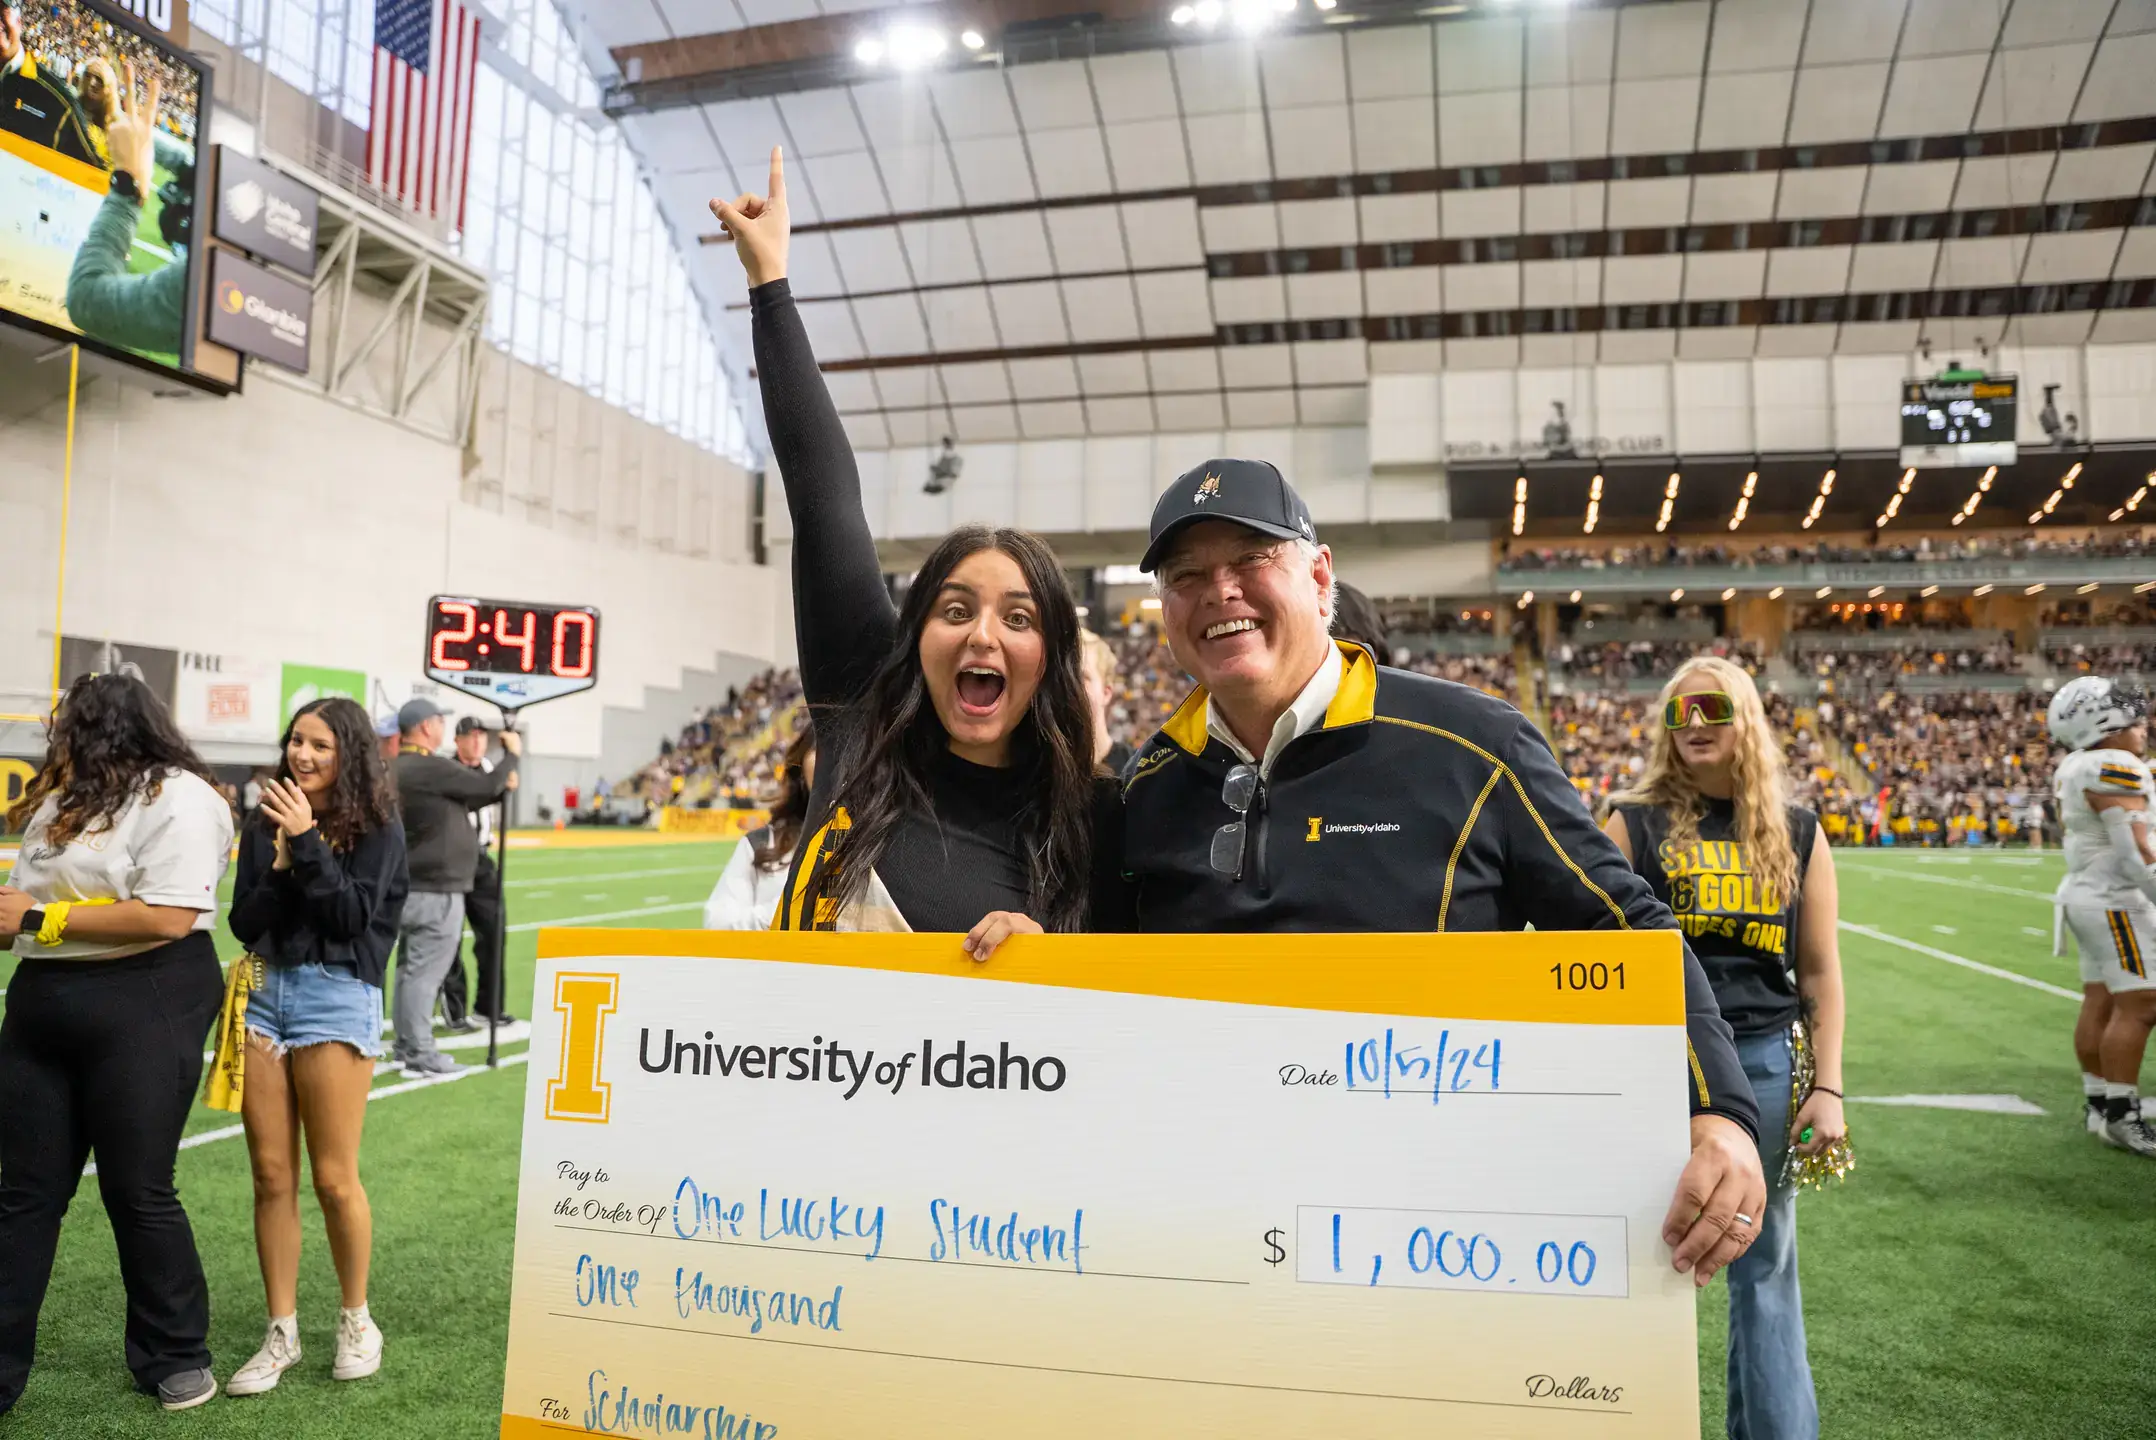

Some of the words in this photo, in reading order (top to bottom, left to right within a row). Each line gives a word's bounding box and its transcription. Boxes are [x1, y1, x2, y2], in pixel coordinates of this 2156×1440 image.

[431, 602, 595, 679] 2:40
[184, 652, 222, 673] FREE
[1325, 824, 1368, 834] University
[1375, 823, 1400, 832] Idaho
[1698, 873, 1780, 915] GOLD
[1551, 962, 1626, 991] 1001
[639, 1028, 874, 1101] University
[875, 1053, 917, 1096] of
[921, 1039, 1067, 1093] Idaho
[1279, 1064, 1339, 1086] Date
[1345, 1028, 1505, 1106] 10/5/24
[557, 1161, 591, 1191] Pay
[595, 1168, 611, 1183] to
[553, 1197, 580, 1217] the
[583, 1199, 634, 1224] Order
[637, 1204, 668, 1235] Of
[929, 1198, 1090, 1276] Student
[1264, 1226, 1287, 1267] $
[576, 1253, 640, 1308] One
[675, 1267, 844, 1334] thousand
[540, 1398, 571, 1421] For
[1524, 1374, 1624, 1404] Dollars
